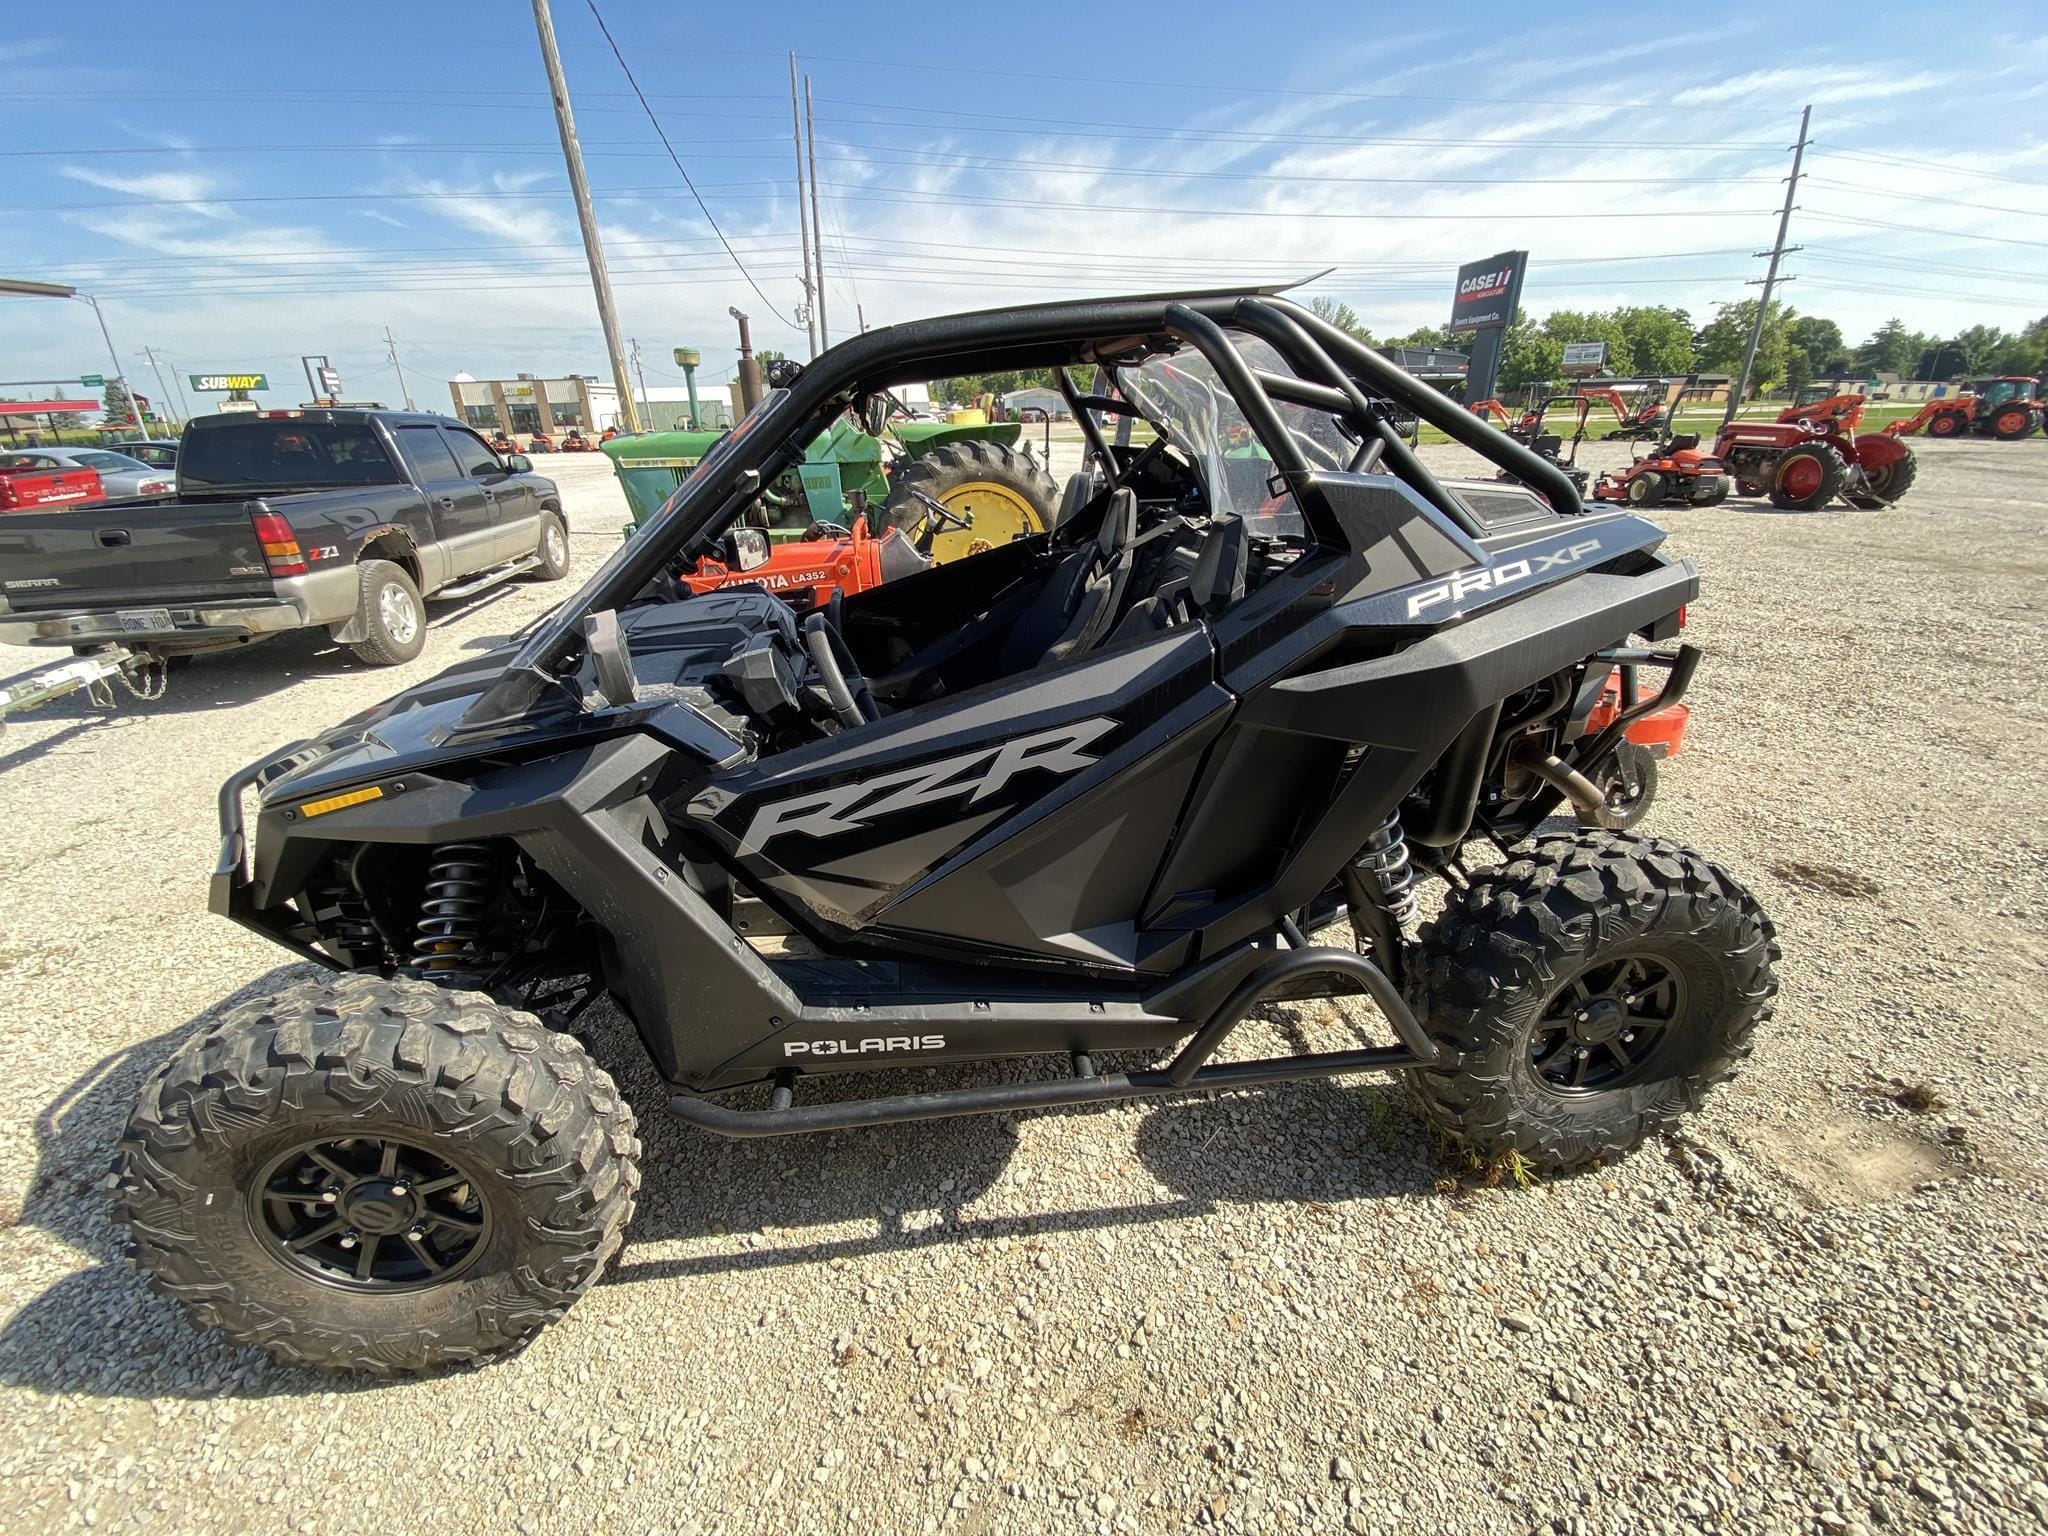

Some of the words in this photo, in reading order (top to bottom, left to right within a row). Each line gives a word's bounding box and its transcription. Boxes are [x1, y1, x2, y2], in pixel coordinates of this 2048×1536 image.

[1461, 273, 1496, 294] CASE
[197, 376, 262, 389] SUBWAY
[23, 483, 97, 498] CHEVROLET
[309, 545, 340, 560] Z71
[229, 566, 264, 576] GMC
[792, 571, 826, 583] LA352
[4, 577, 62, 589] SIERRA
[1408, 559, 1532, 619] PRO
[1532, 539, 1602, 574] XP
[734, 715, 1120, 858] RZR
[784, 1034, 946, 1057] POLARIS
